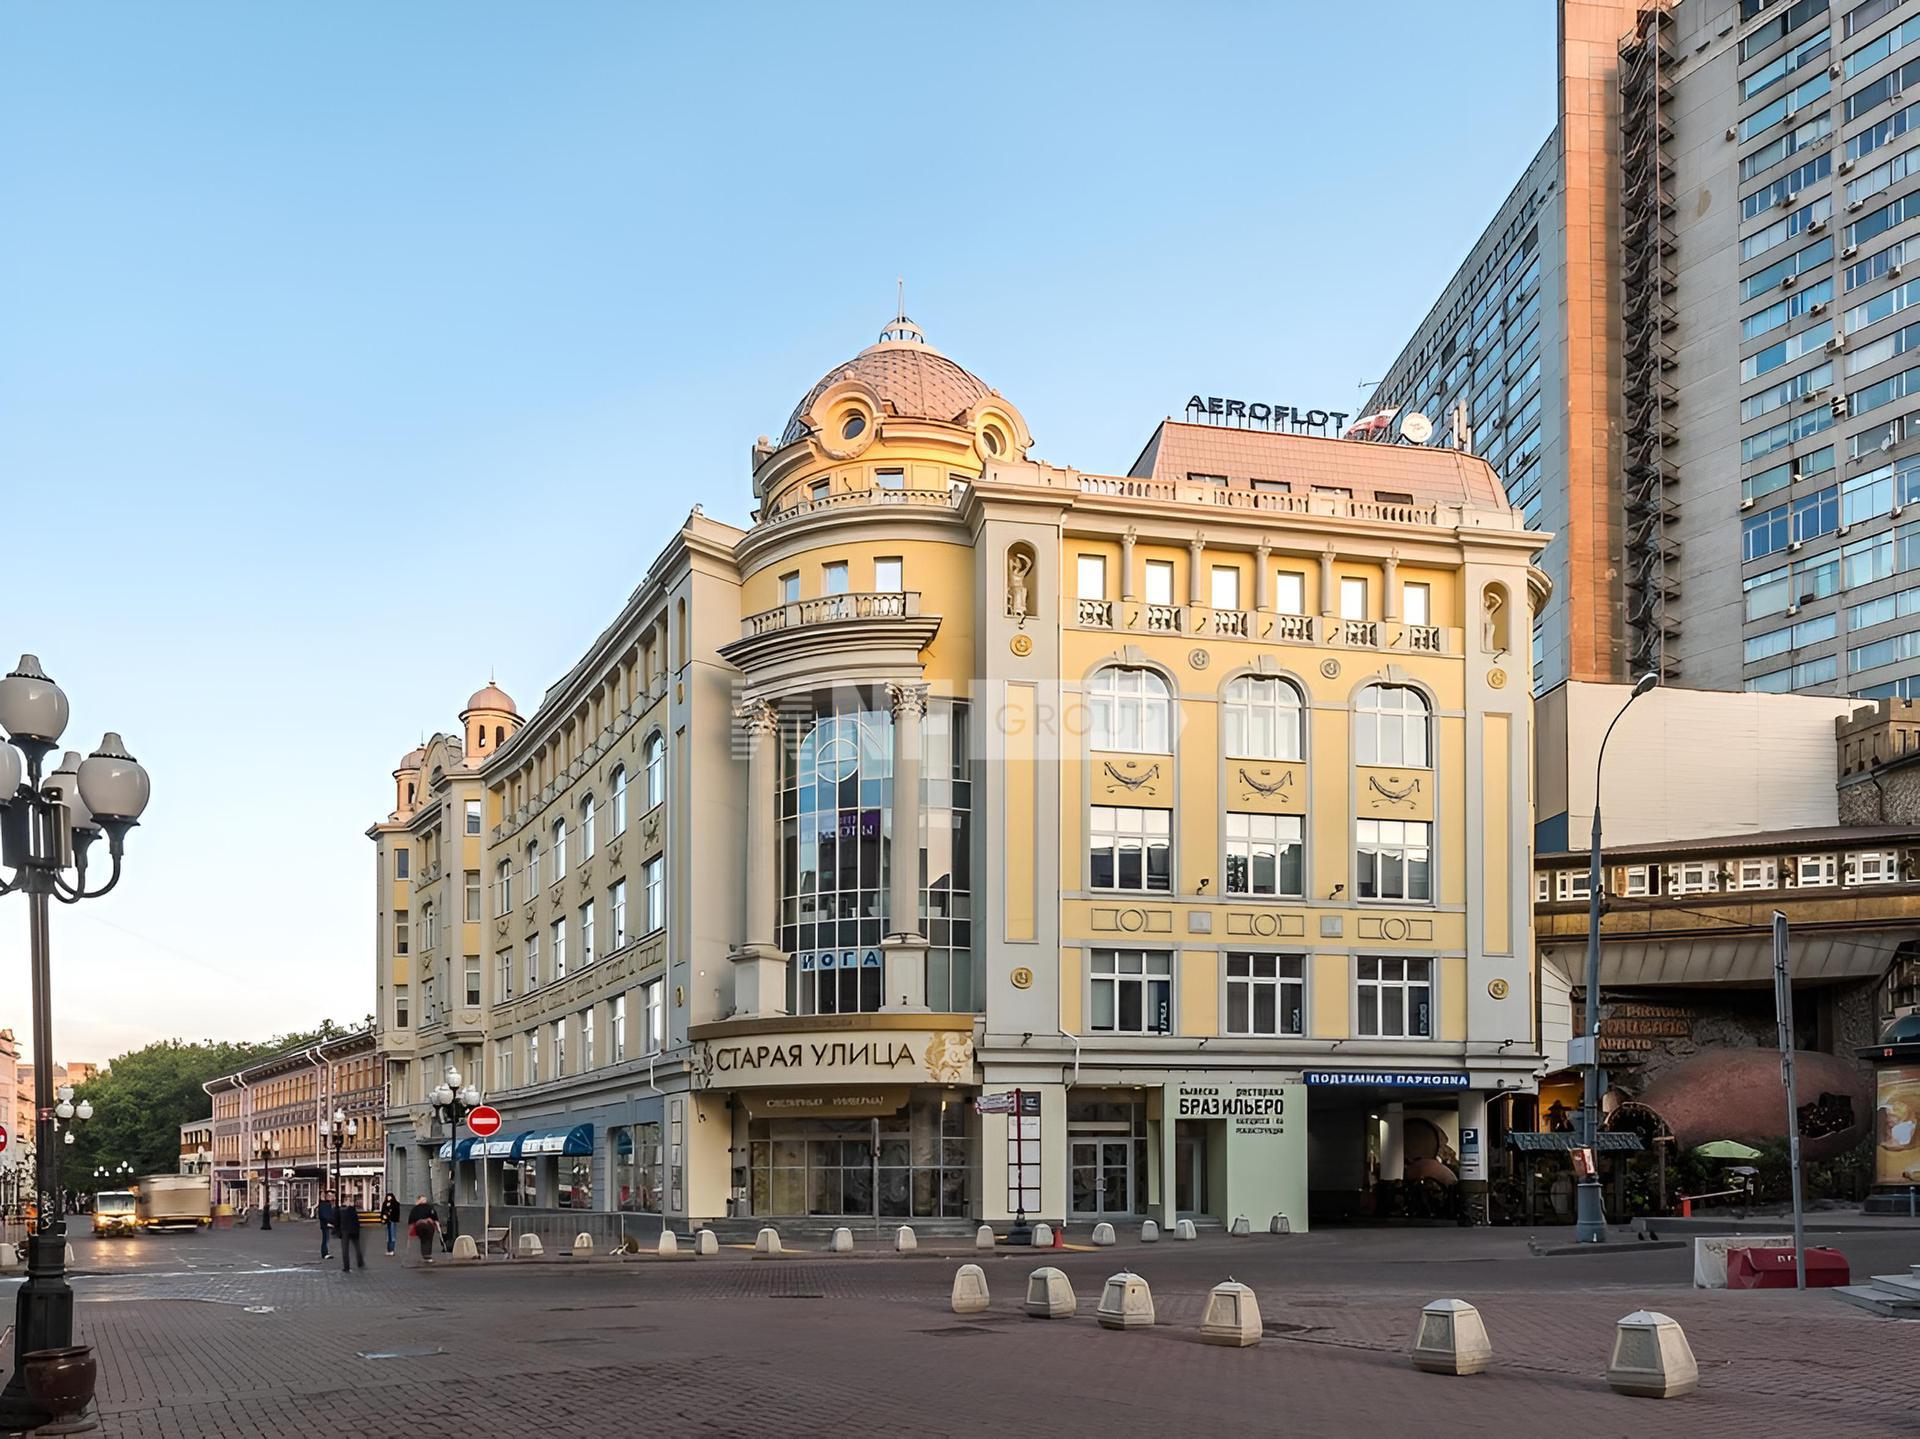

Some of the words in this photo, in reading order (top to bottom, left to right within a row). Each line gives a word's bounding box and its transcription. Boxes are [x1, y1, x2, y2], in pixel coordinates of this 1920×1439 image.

[1185, 394, 1349, 429] AEROFLOT
[716, 1044, 802, 1071] СТАРАЯ
[811, 1042, 916, 1069] УЛИЦА
[1463, 1130, 1475, 1144] P
